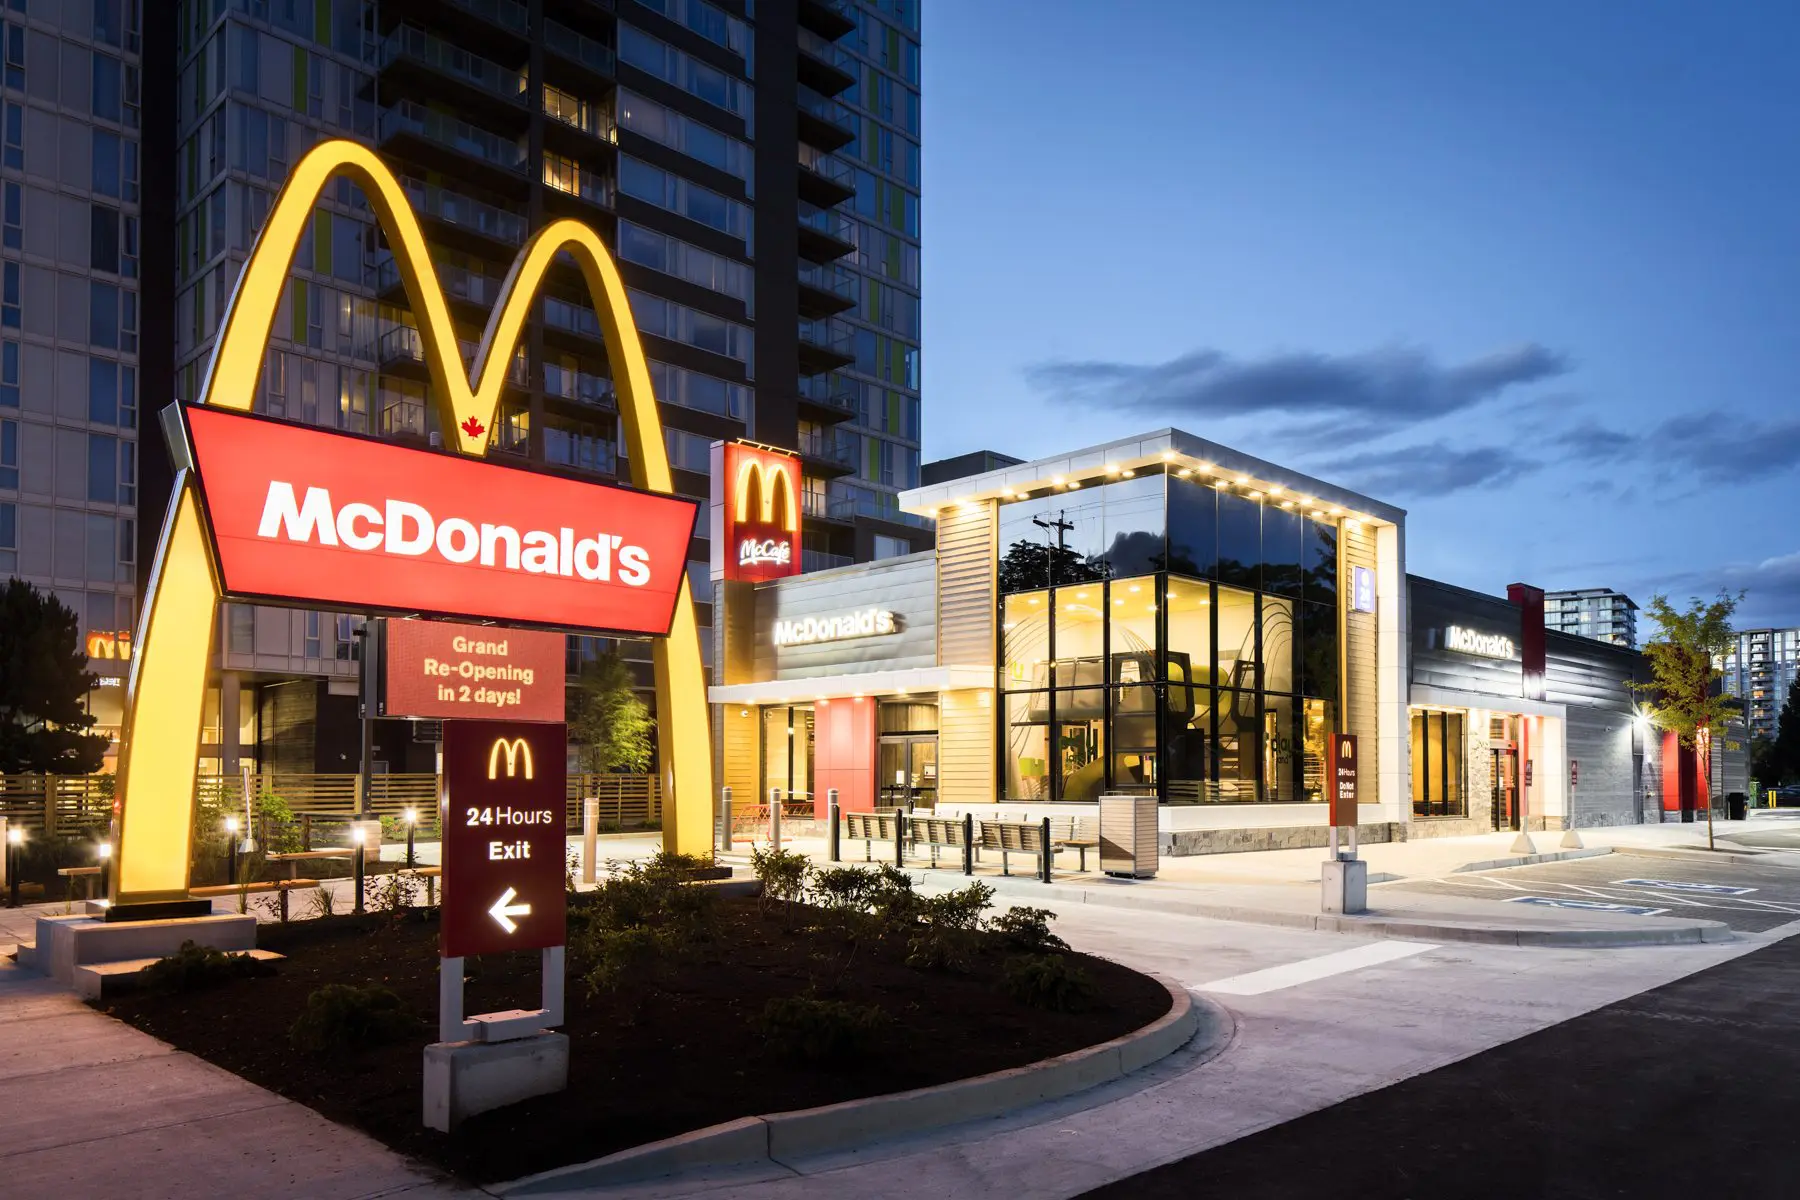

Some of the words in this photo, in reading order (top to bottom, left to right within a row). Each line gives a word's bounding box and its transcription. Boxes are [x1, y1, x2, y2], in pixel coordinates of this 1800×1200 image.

[257, 480, 651, 586] McDonald's
[774, 608, 895, 646] McDonald's
[452, 635, 509, 657] Grand
[1446, 625, 1513, 659] McDonald's
[423, 658, 534, 686] Re-Opening
[437, 684, 455, 702] in
[458, 685, 471, 702] 2
[473, 686, 522, 708] days!
[1338, 767, 1344, 776] 24
[1344, 768, 1356, 777] Hours
[1339, 781, 1346, 790] Do
[1346, 781, 1355, 790] Not
[1339, 790, 1355, 799] Enter
[466, 807, 493, 826] 24
[496, 807, 553, 825] Hours
[488, 841, 531, 861] Exit
